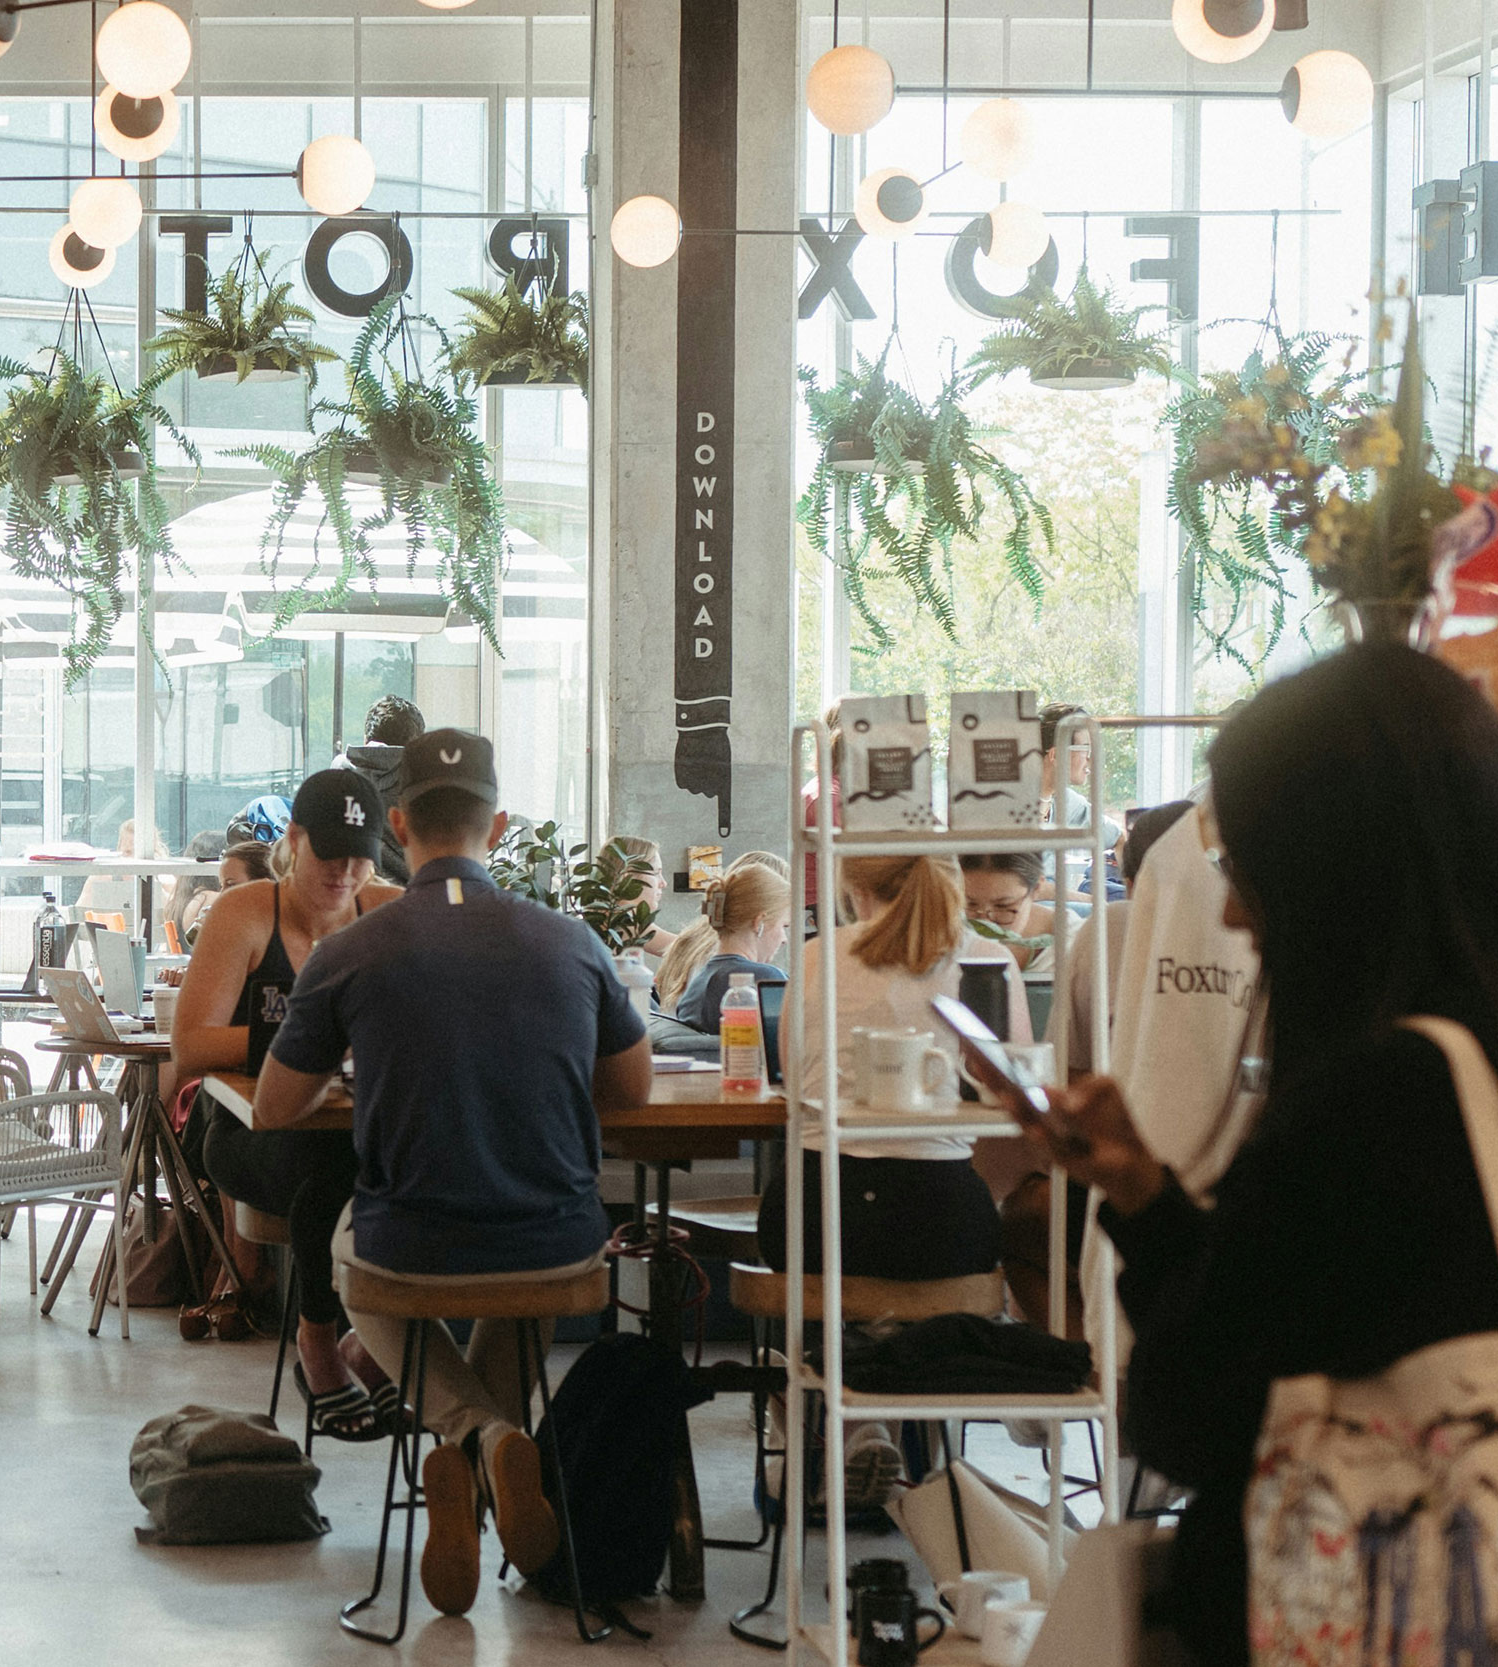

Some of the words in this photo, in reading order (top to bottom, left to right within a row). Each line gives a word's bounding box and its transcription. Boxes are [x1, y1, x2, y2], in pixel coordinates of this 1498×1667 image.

[692, 412, 717, 658] DOWNLOAD
[344, 795, 366, 827] LA
[42, 929, 53, 967] essentia
